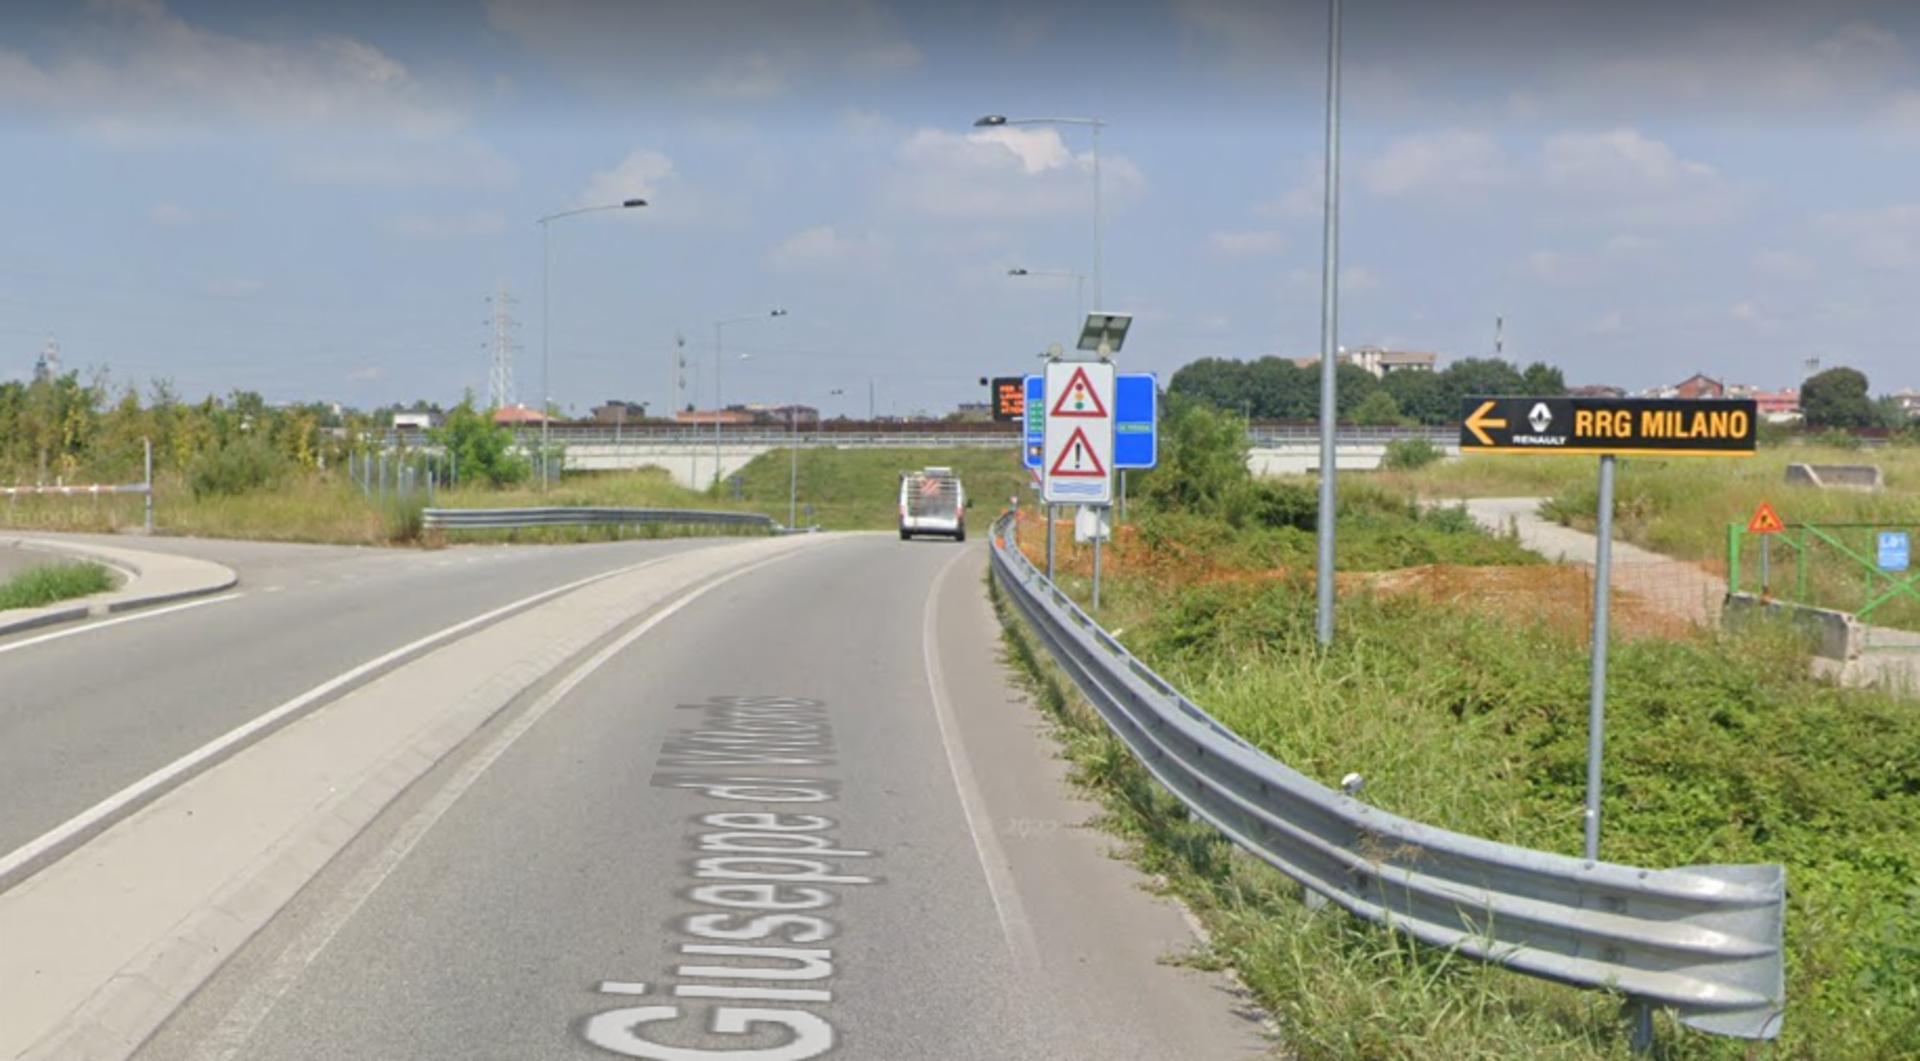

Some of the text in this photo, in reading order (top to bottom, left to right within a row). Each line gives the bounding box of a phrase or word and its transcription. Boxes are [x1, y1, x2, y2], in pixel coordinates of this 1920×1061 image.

[1575, 410, 1748, 438] RRG MILANO
[1512, 435, 1566, 445] RENAULT
